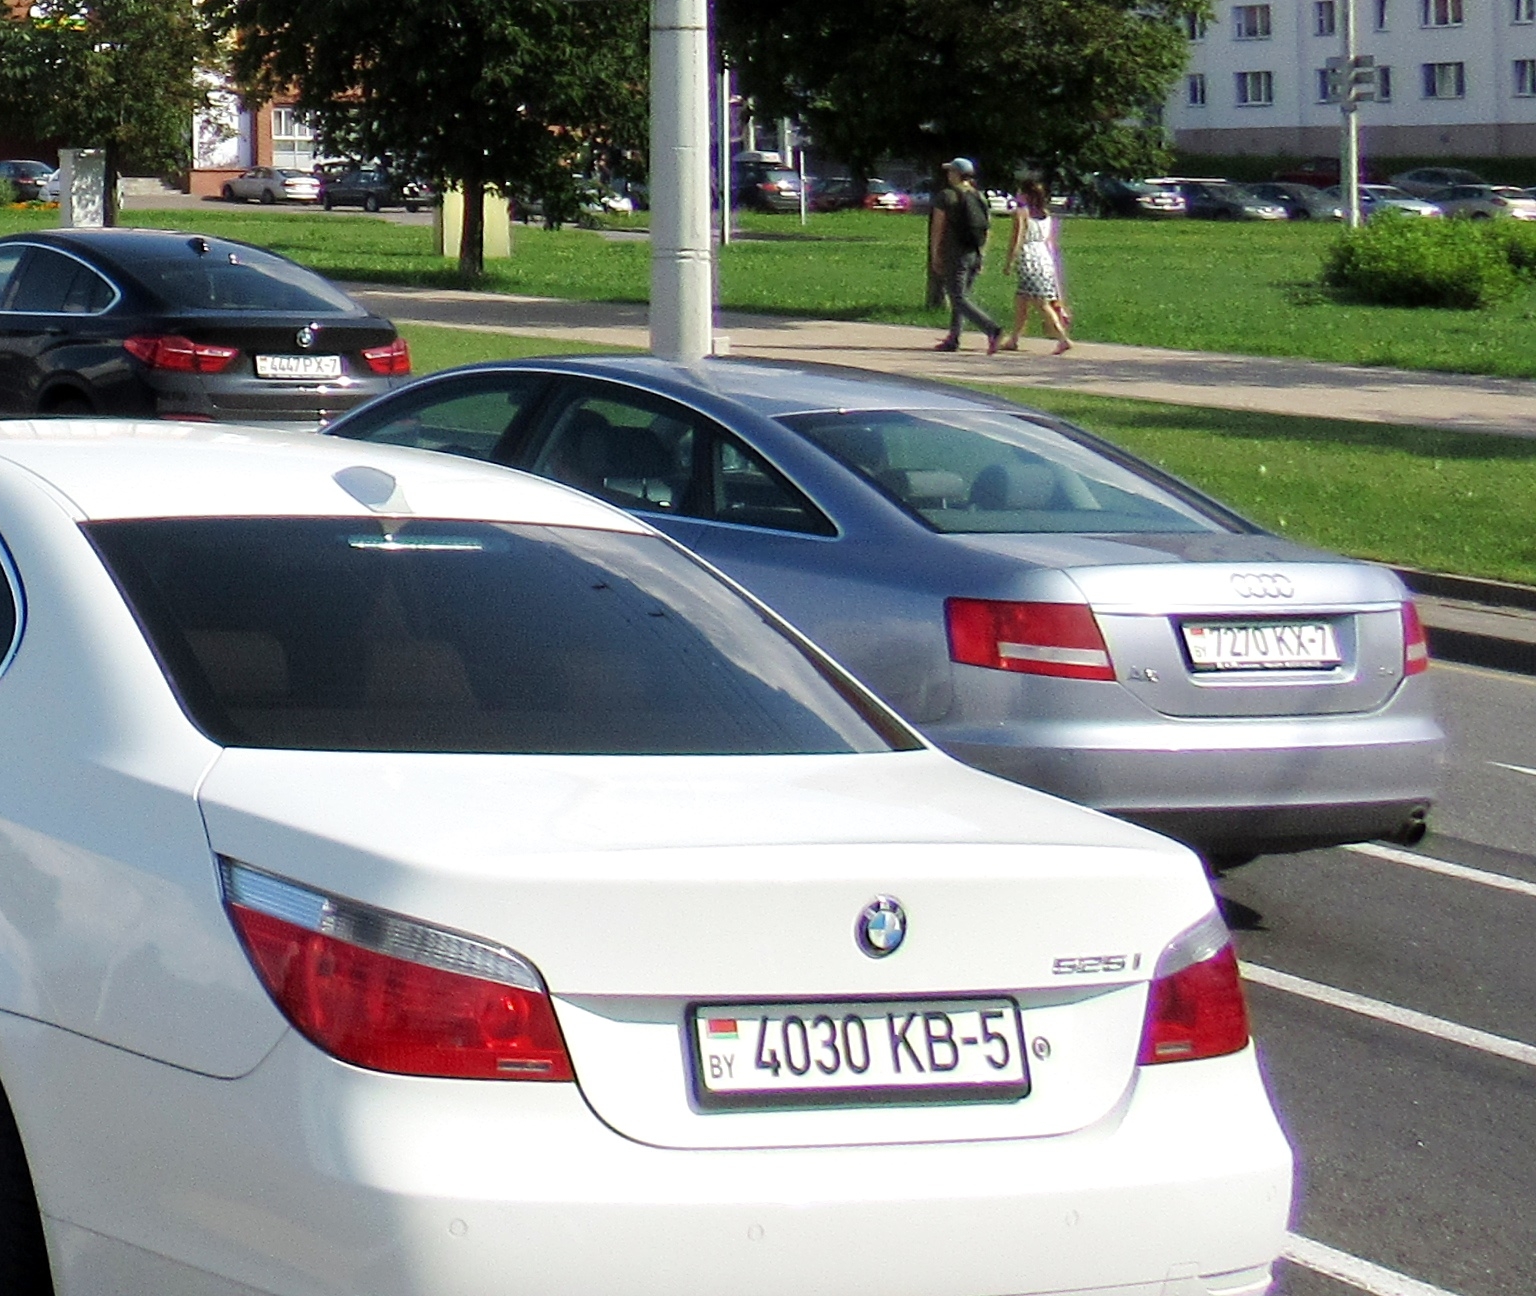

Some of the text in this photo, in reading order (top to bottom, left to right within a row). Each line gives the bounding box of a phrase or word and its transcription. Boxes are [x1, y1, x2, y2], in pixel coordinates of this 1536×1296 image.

[754, 1007, 1010, 1078] 4030 KB-5
[709, 1054, 736, 1080] BY
